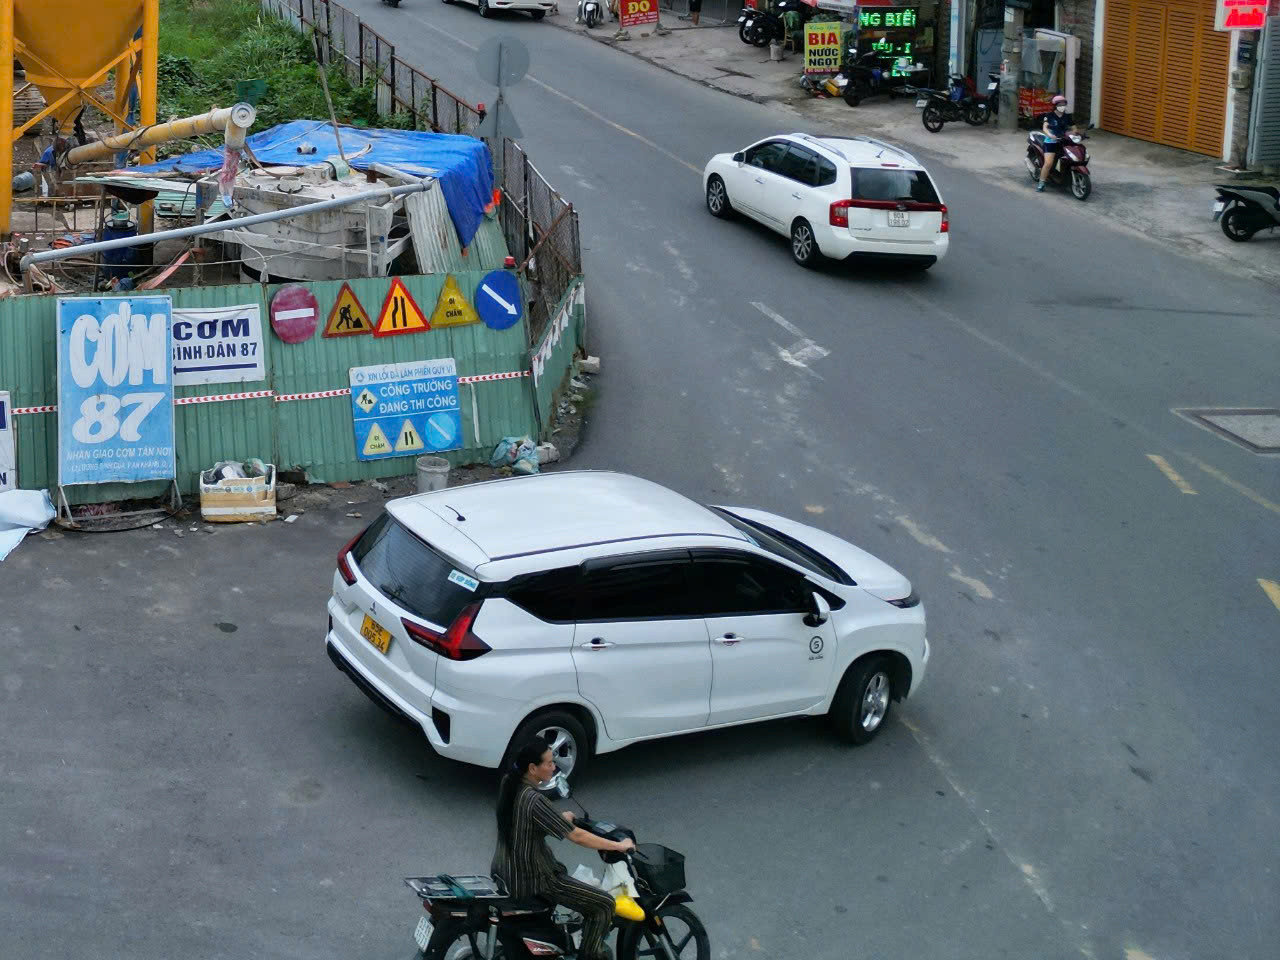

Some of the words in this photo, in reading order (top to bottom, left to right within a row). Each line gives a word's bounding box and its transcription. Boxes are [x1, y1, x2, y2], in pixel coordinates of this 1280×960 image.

[808, 32, 839, 46] BIA
[808, 47, 839, 57] NƯỚC
[808, 57, 838, 67] NGỌT
[172, 317, 251, 341] CƠM
[69, 301, 167, 388] CƠM
[206, 341, 236, 359] DÂN
[240, 342, 258, 357] 87
[400, 366, 413, 378] LÀM
[380, 383, 411, 397] CÔNG
[411, 378, 453, 394] TRƯỜNG
[379, 400, 409, 414] ĐANG
[409, 399, 425, 410] THI
[426, 394, 457, 408] CÔNG
[71, 392, 166, 444] 87
